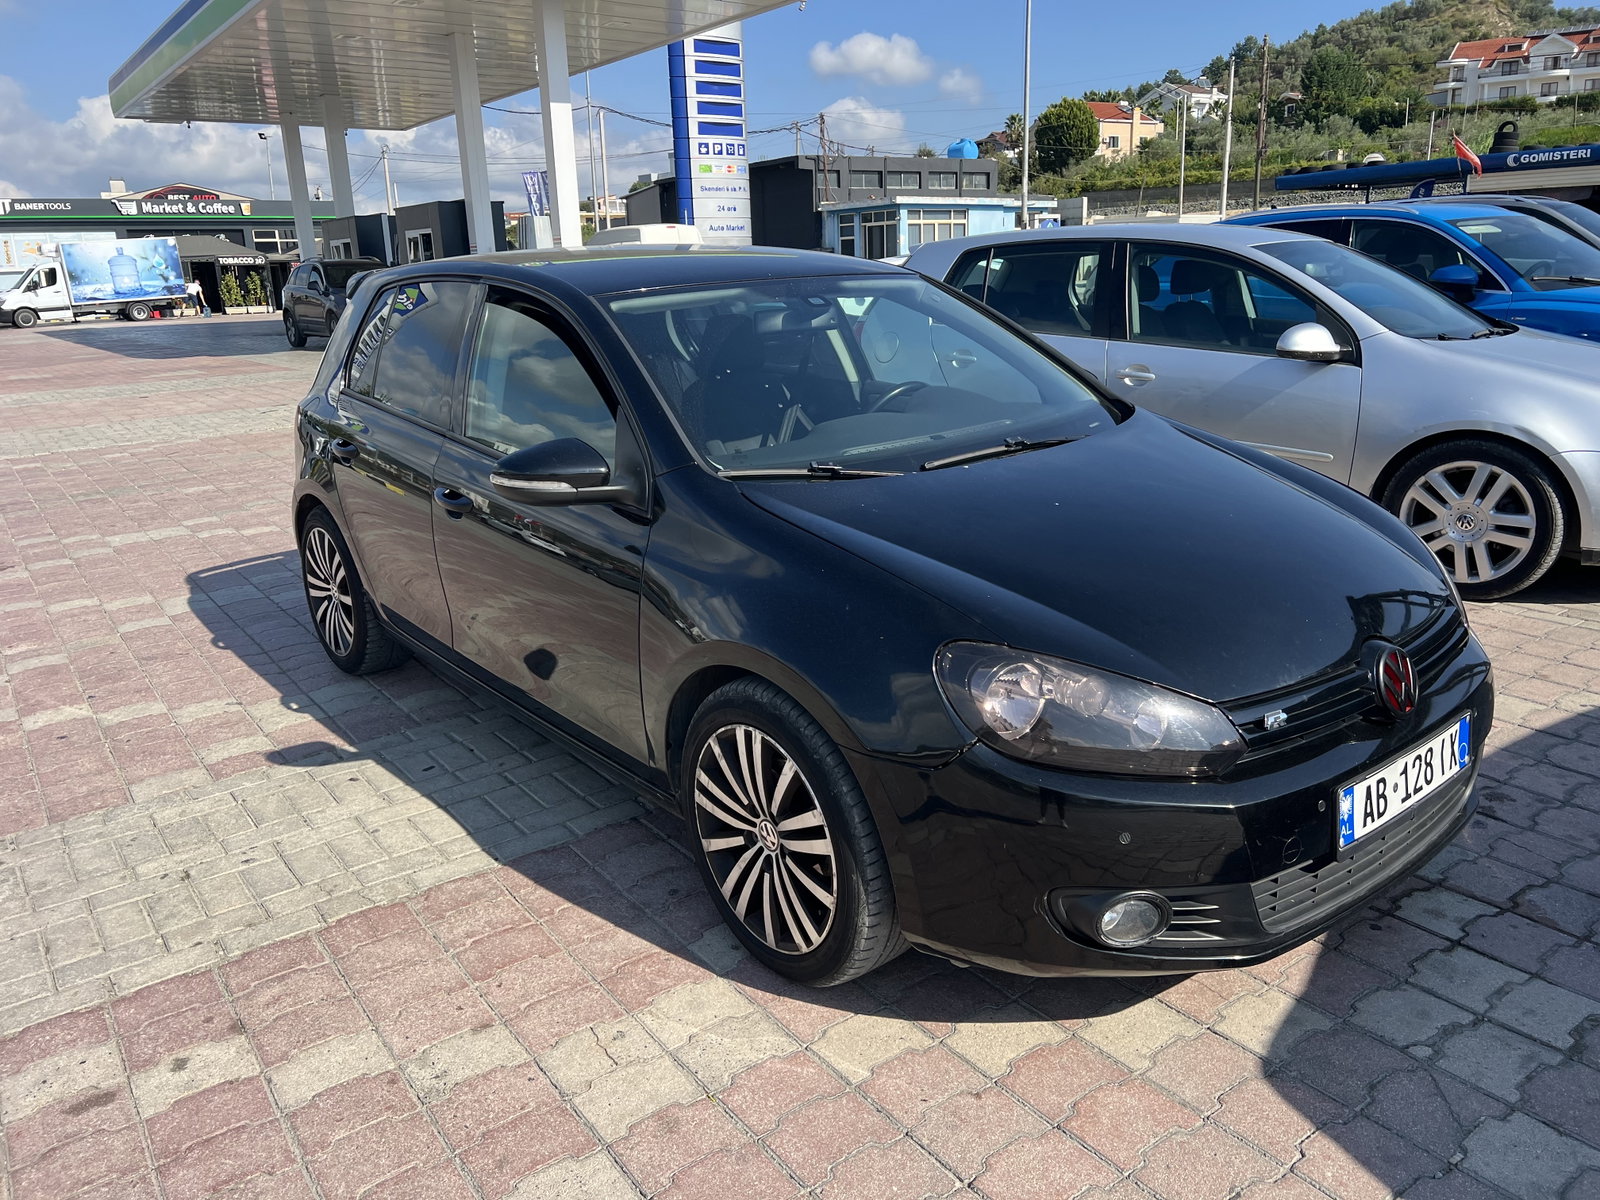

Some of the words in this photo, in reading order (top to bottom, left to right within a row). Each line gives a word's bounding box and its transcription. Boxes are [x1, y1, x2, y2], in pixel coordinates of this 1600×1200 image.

[1520, 149, 1591, 163] GOMISTERI
[14, 202, 71, 211] BANERTOOLS
[141, 202, 184, 214] Market
[186, 202, 197, 214] &
[199, 202, 235, 214] Coffee
[217, 257, 255, 265] TOBACCO
[1362, 777, 1388, 829] AB
[1399, 746, 1434, 804] 128
[1340, 822, 1353, 836] AL
